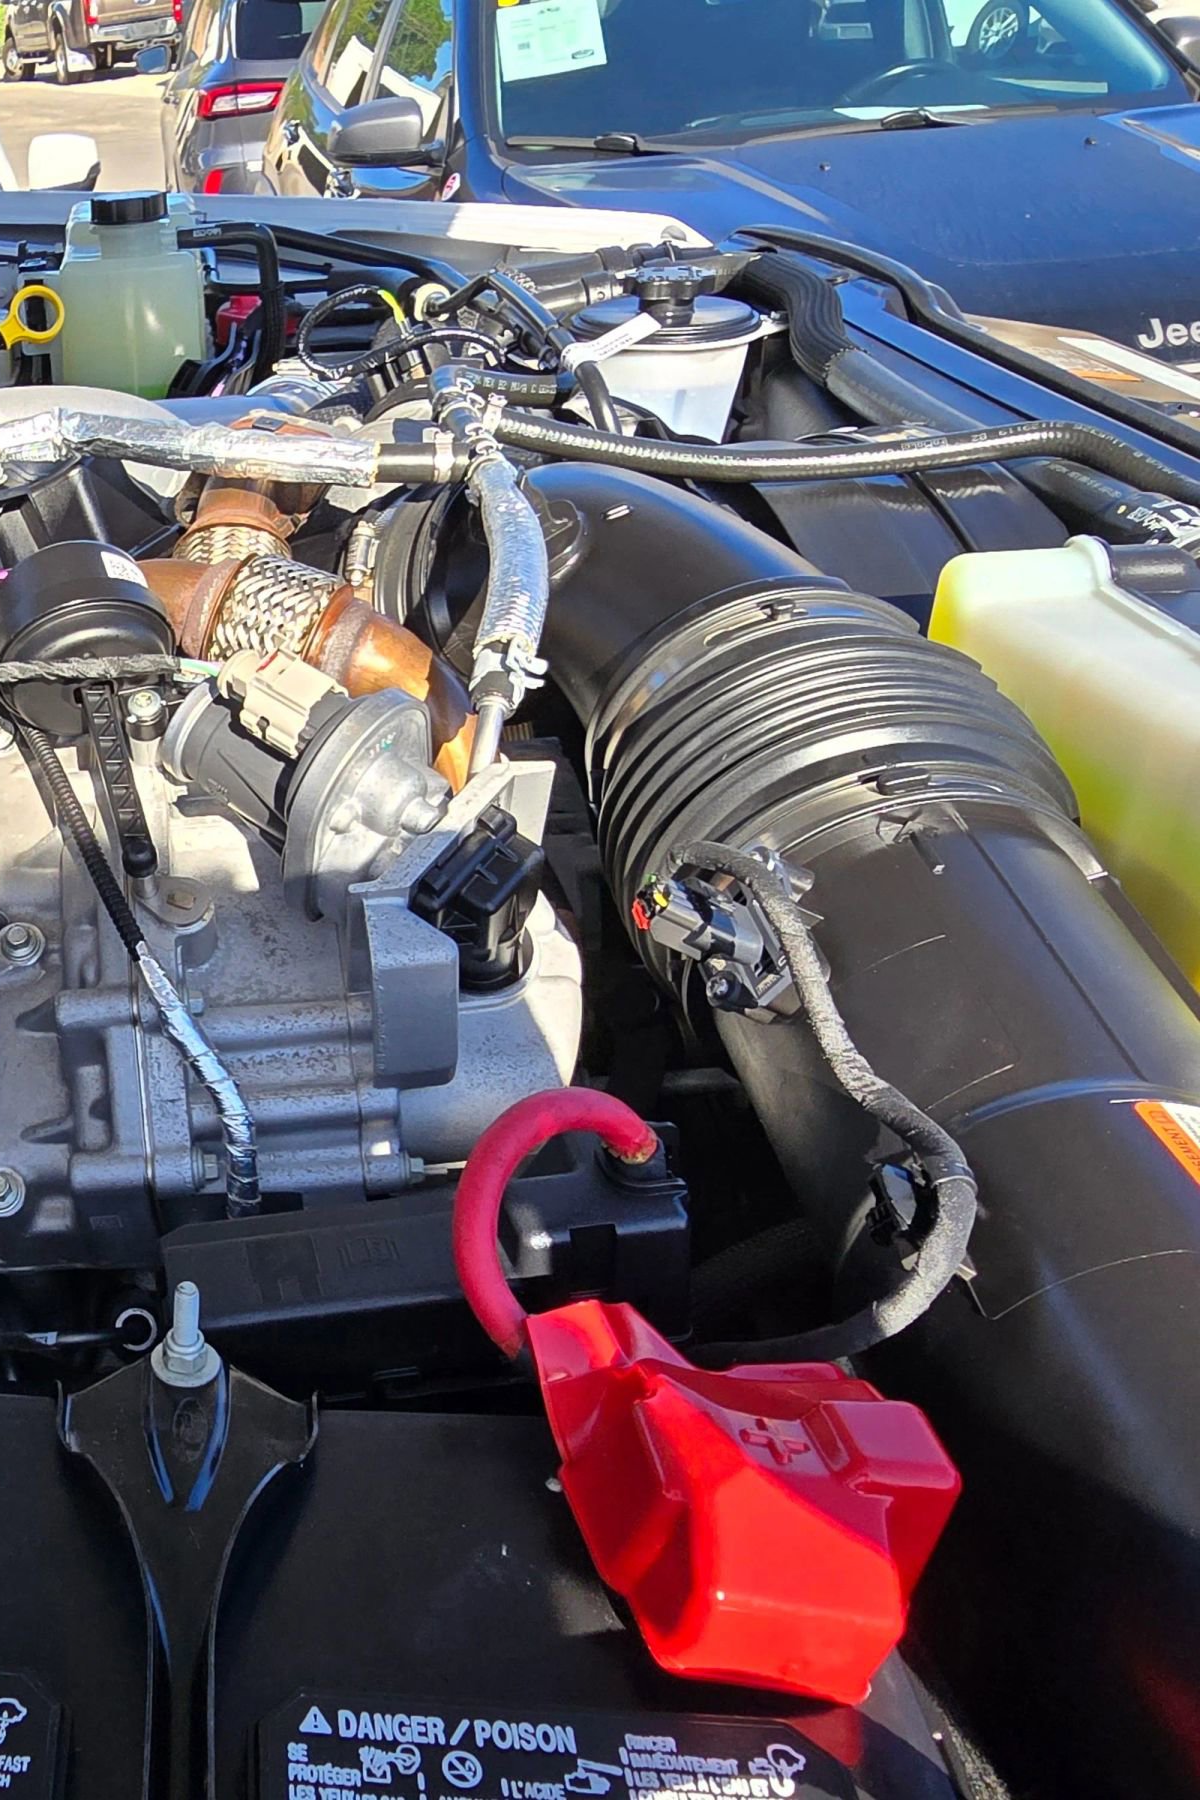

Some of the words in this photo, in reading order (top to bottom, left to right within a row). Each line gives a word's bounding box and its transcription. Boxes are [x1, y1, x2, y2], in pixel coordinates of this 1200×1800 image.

[1137, 317, 1200, 349] Jee
[337, 1709, 446, 1745] DANGER
[473, 1719, 577, 1754] POISON
[287, 1742, 308, 1762] SE
[634, 1771, 660, 1788] LES
[288, 1784, 316, 1800] LES
